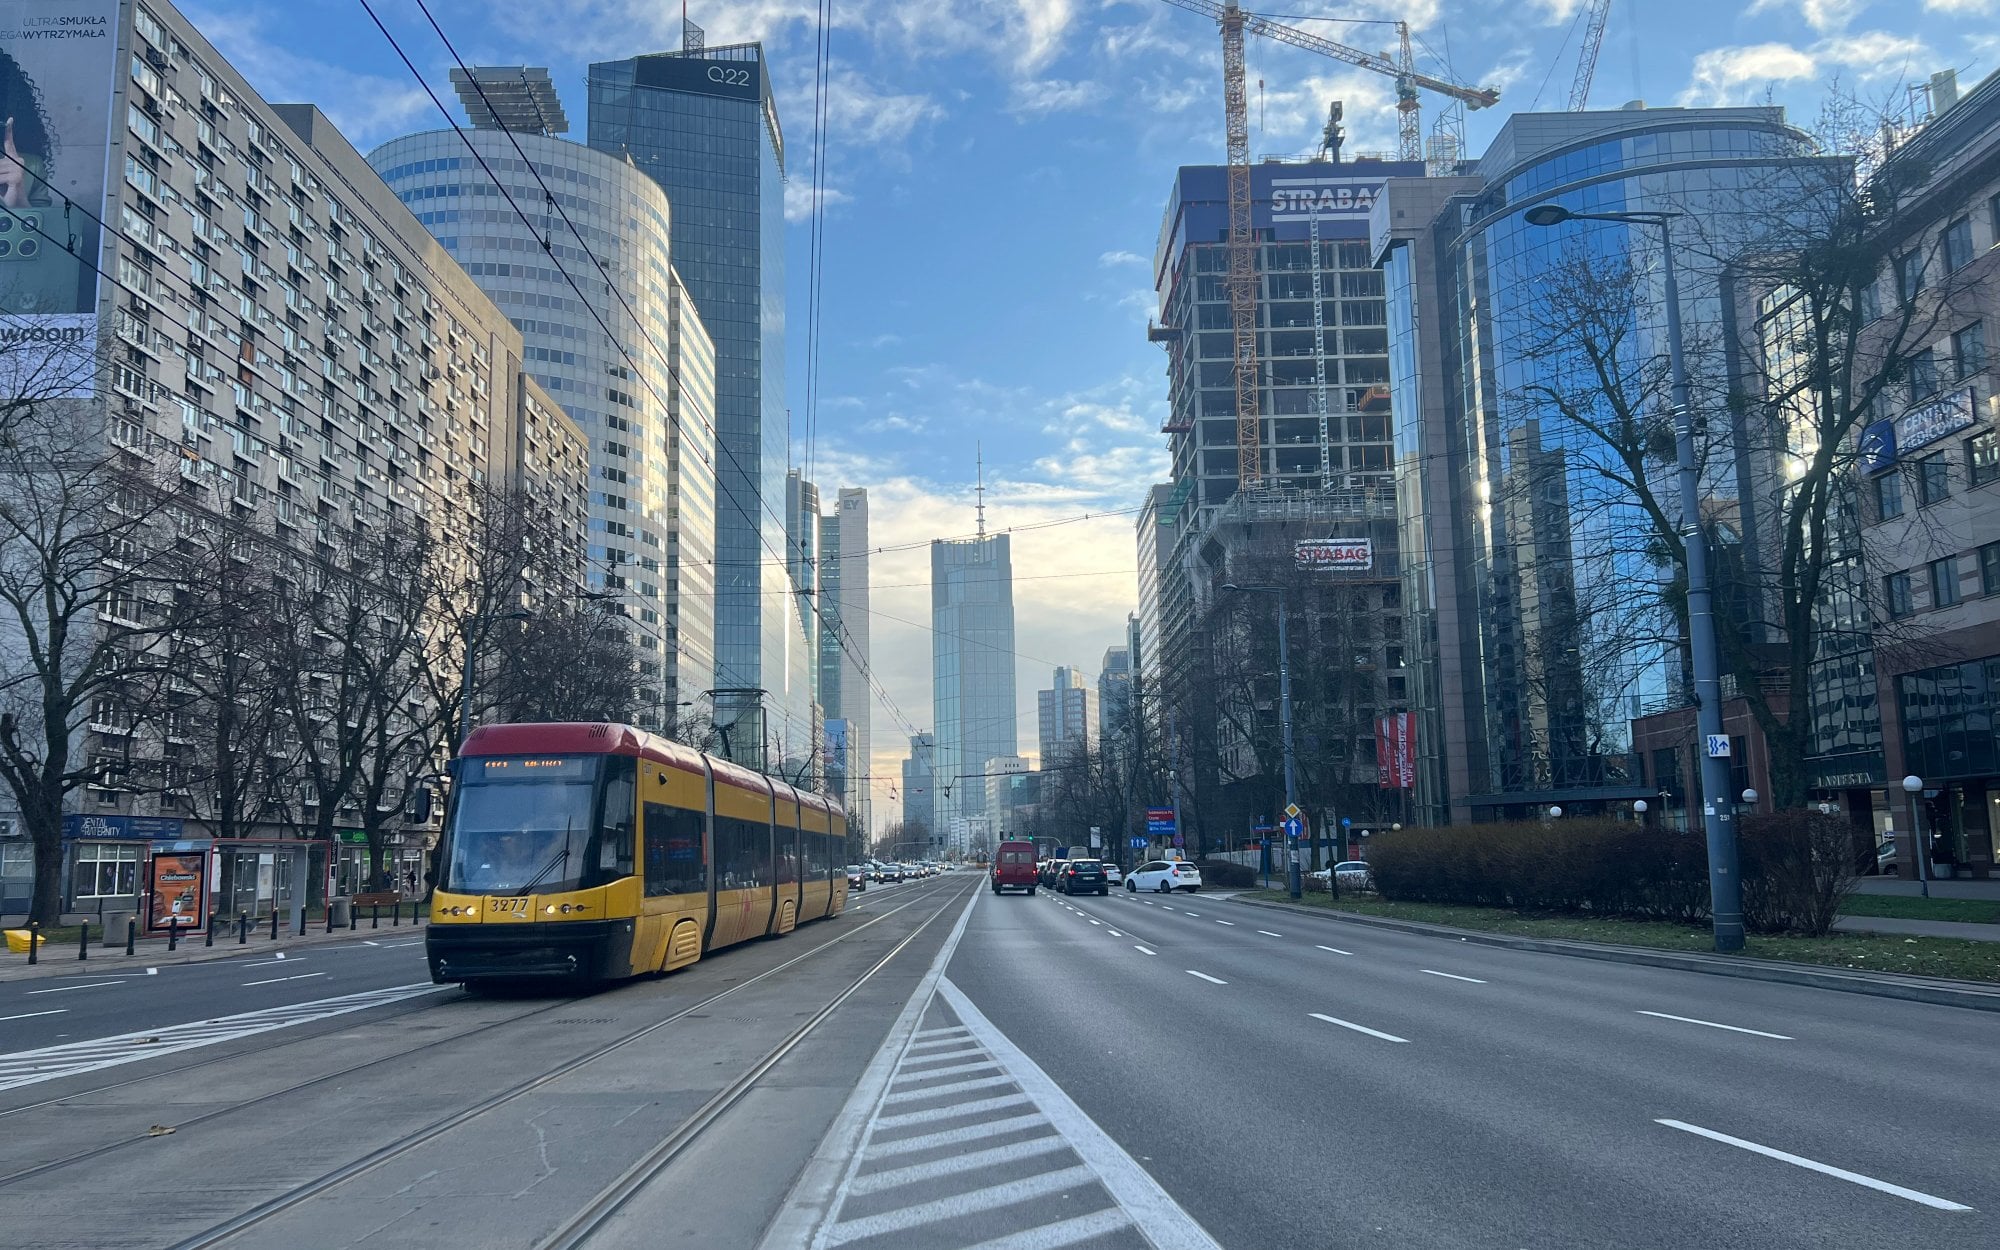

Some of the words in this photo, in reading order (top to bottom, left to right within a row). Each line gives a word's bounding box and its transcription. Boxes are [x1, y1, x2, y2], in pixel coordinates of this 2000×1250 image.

[23, 16, 106, 26] ULTRASMUKŁA
[707, 66, 750, 86] Q22
[843, 500, 860, 510] EY
[490, 898, 529, 913] 3277
